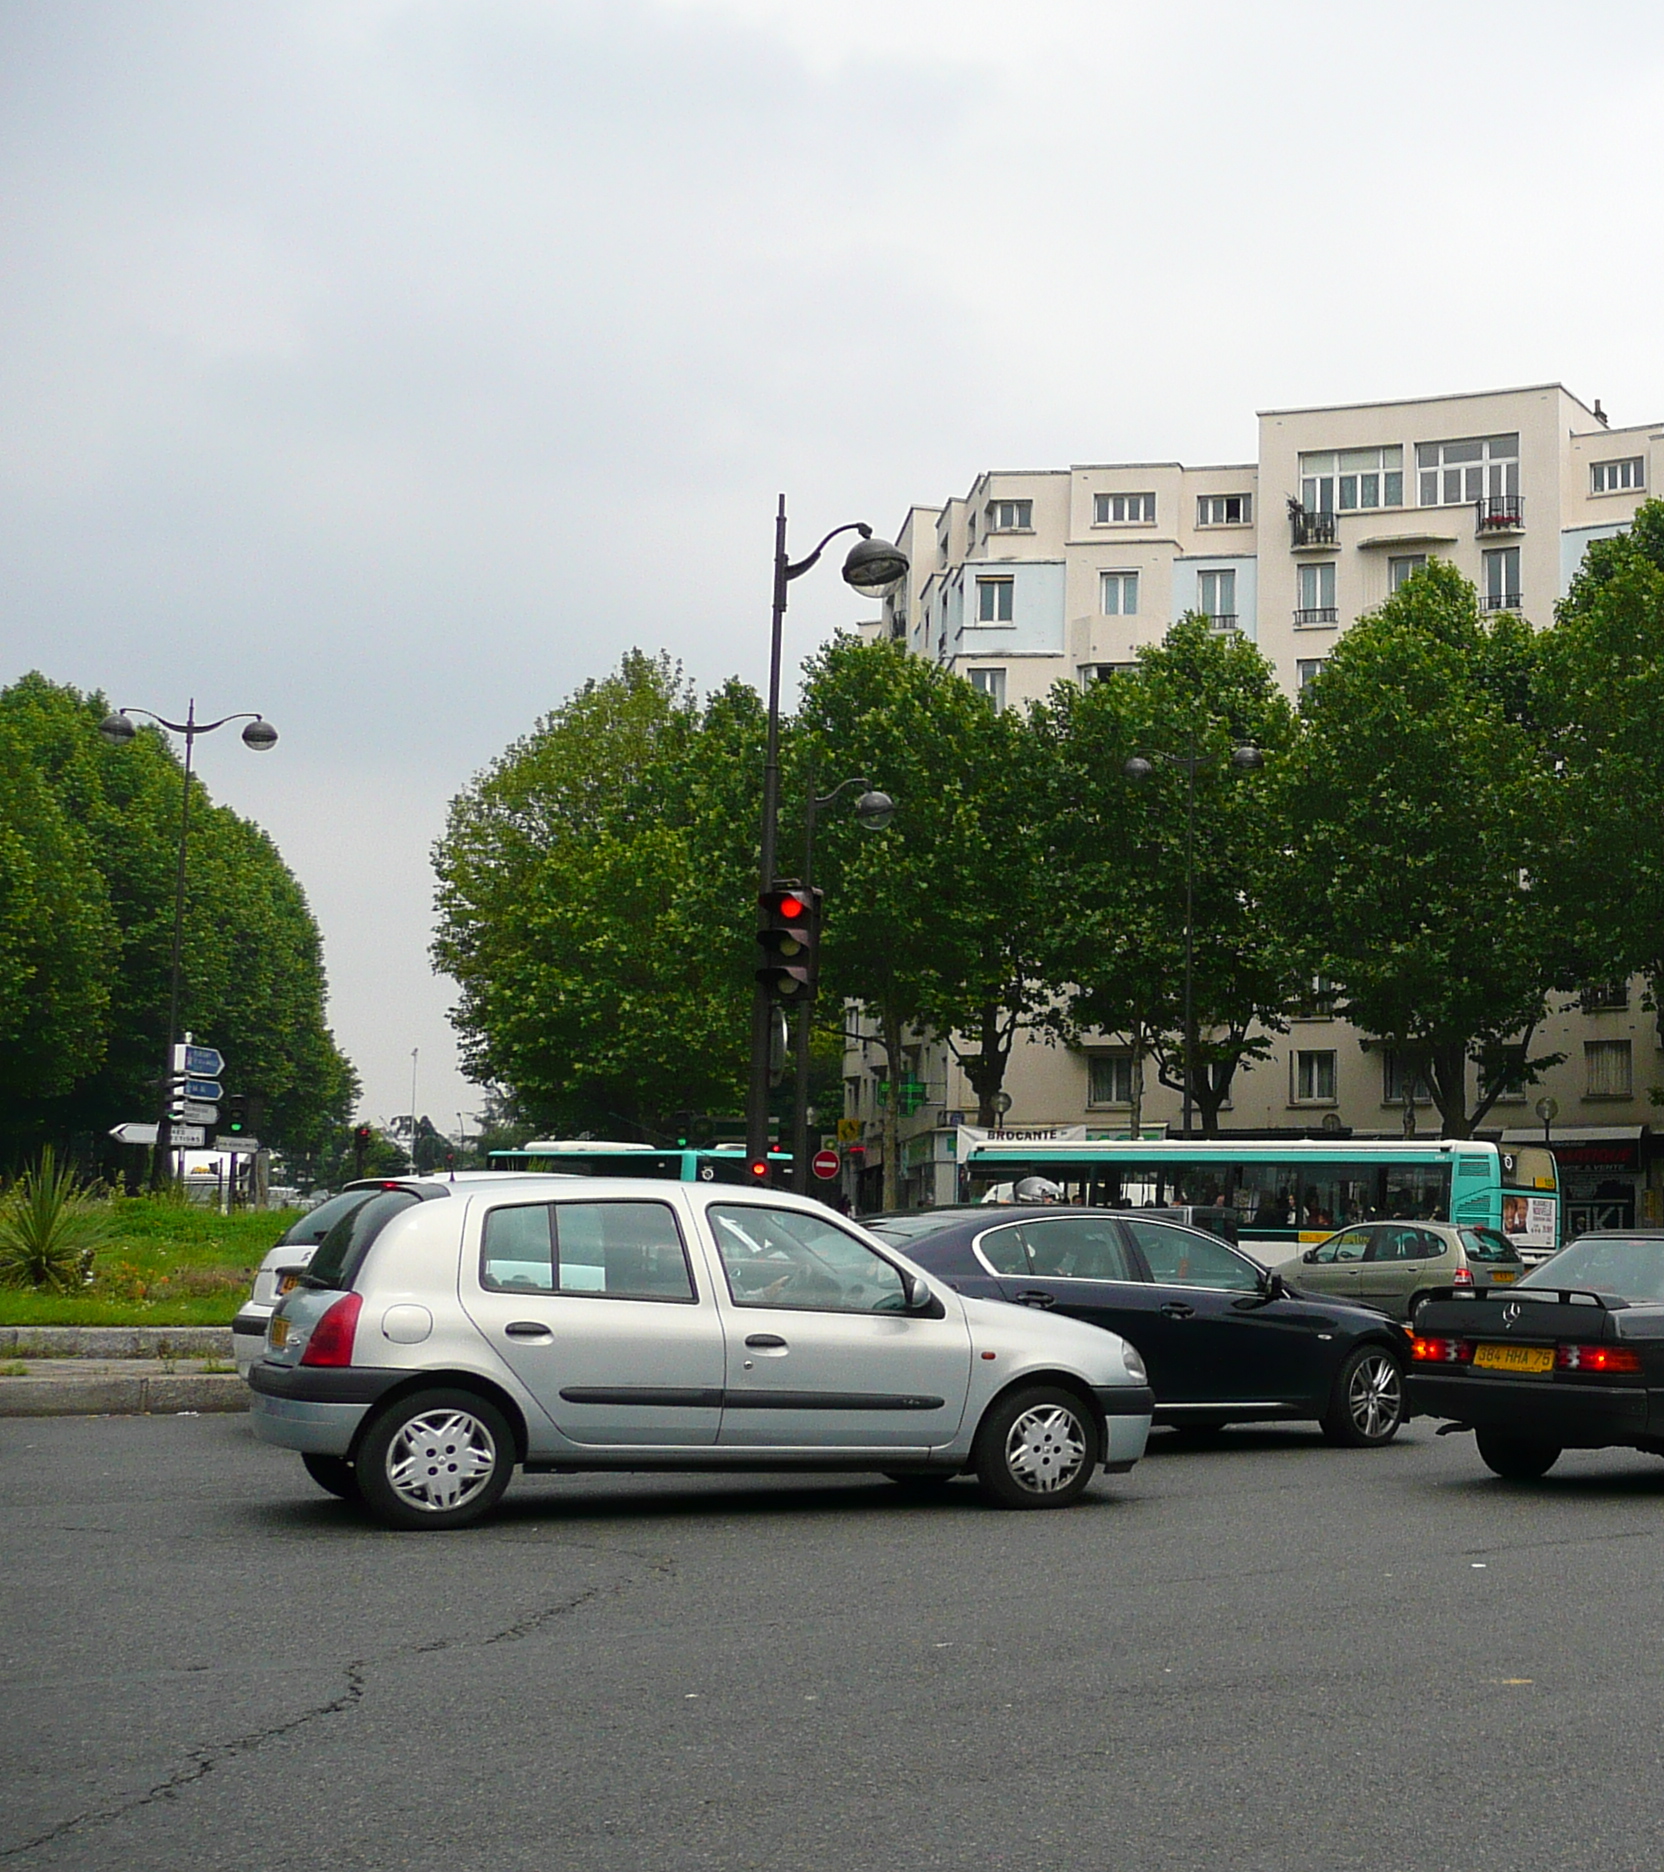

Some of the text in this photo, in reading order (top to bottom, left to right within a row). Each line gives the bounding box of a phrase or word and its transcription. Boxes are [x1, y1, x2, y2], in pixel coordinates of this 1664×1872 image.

[987, 1129, 1058, 1141] BROCANTE
[1478, 1347, 1500, 1361] 384
[1534, 1350, 1551, 1366] 75
